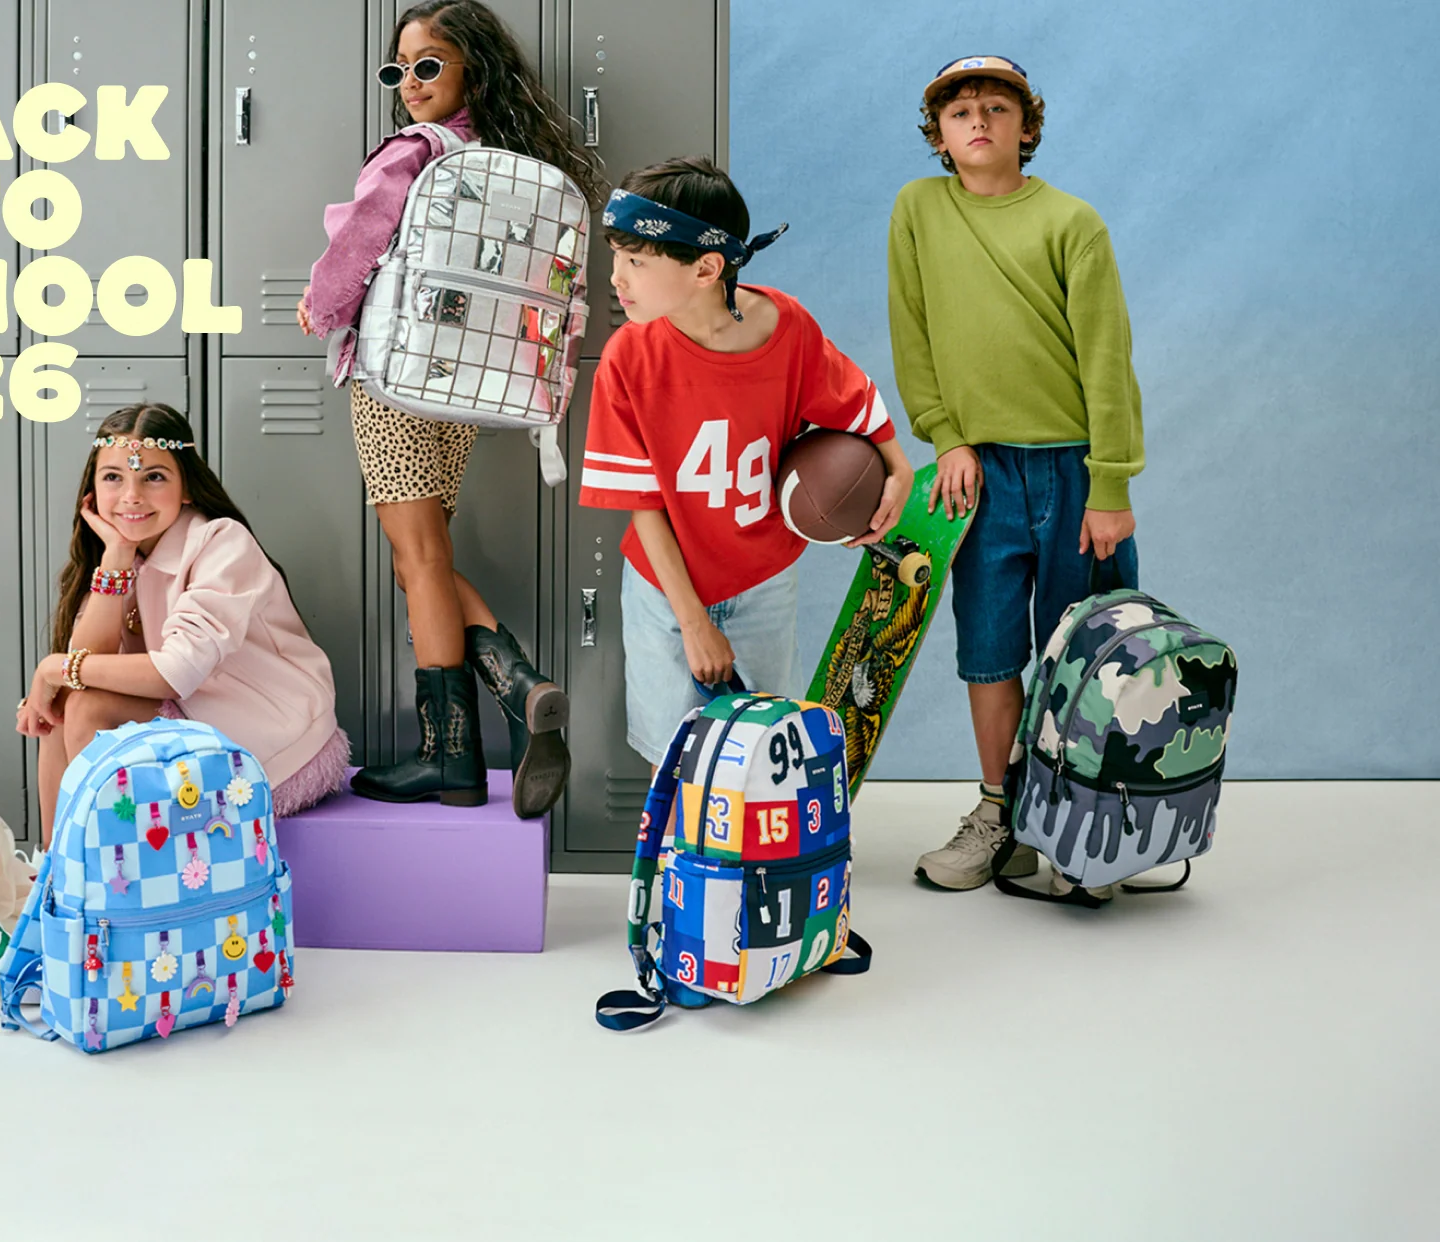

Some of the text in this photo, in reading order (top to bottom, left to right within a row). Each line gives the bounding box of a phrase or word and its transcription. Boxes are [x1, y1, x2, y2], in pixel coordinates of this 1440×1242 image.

[676, 419, 771, 528] 49
[768, 720, 805, 786] 99
[832, 760, 844, 814] 5
[757, 806, 790, 846] 15
[806, 798, 821, 835] 3
[667, 870, 685, 911] 11
[815, 875, 830, 911] 2
[776, 887, 792, 939] 1
[676, 949, 698, 986] 3
[765, 952, 792, 989] 17
[802, 928, 830, 972] 0
